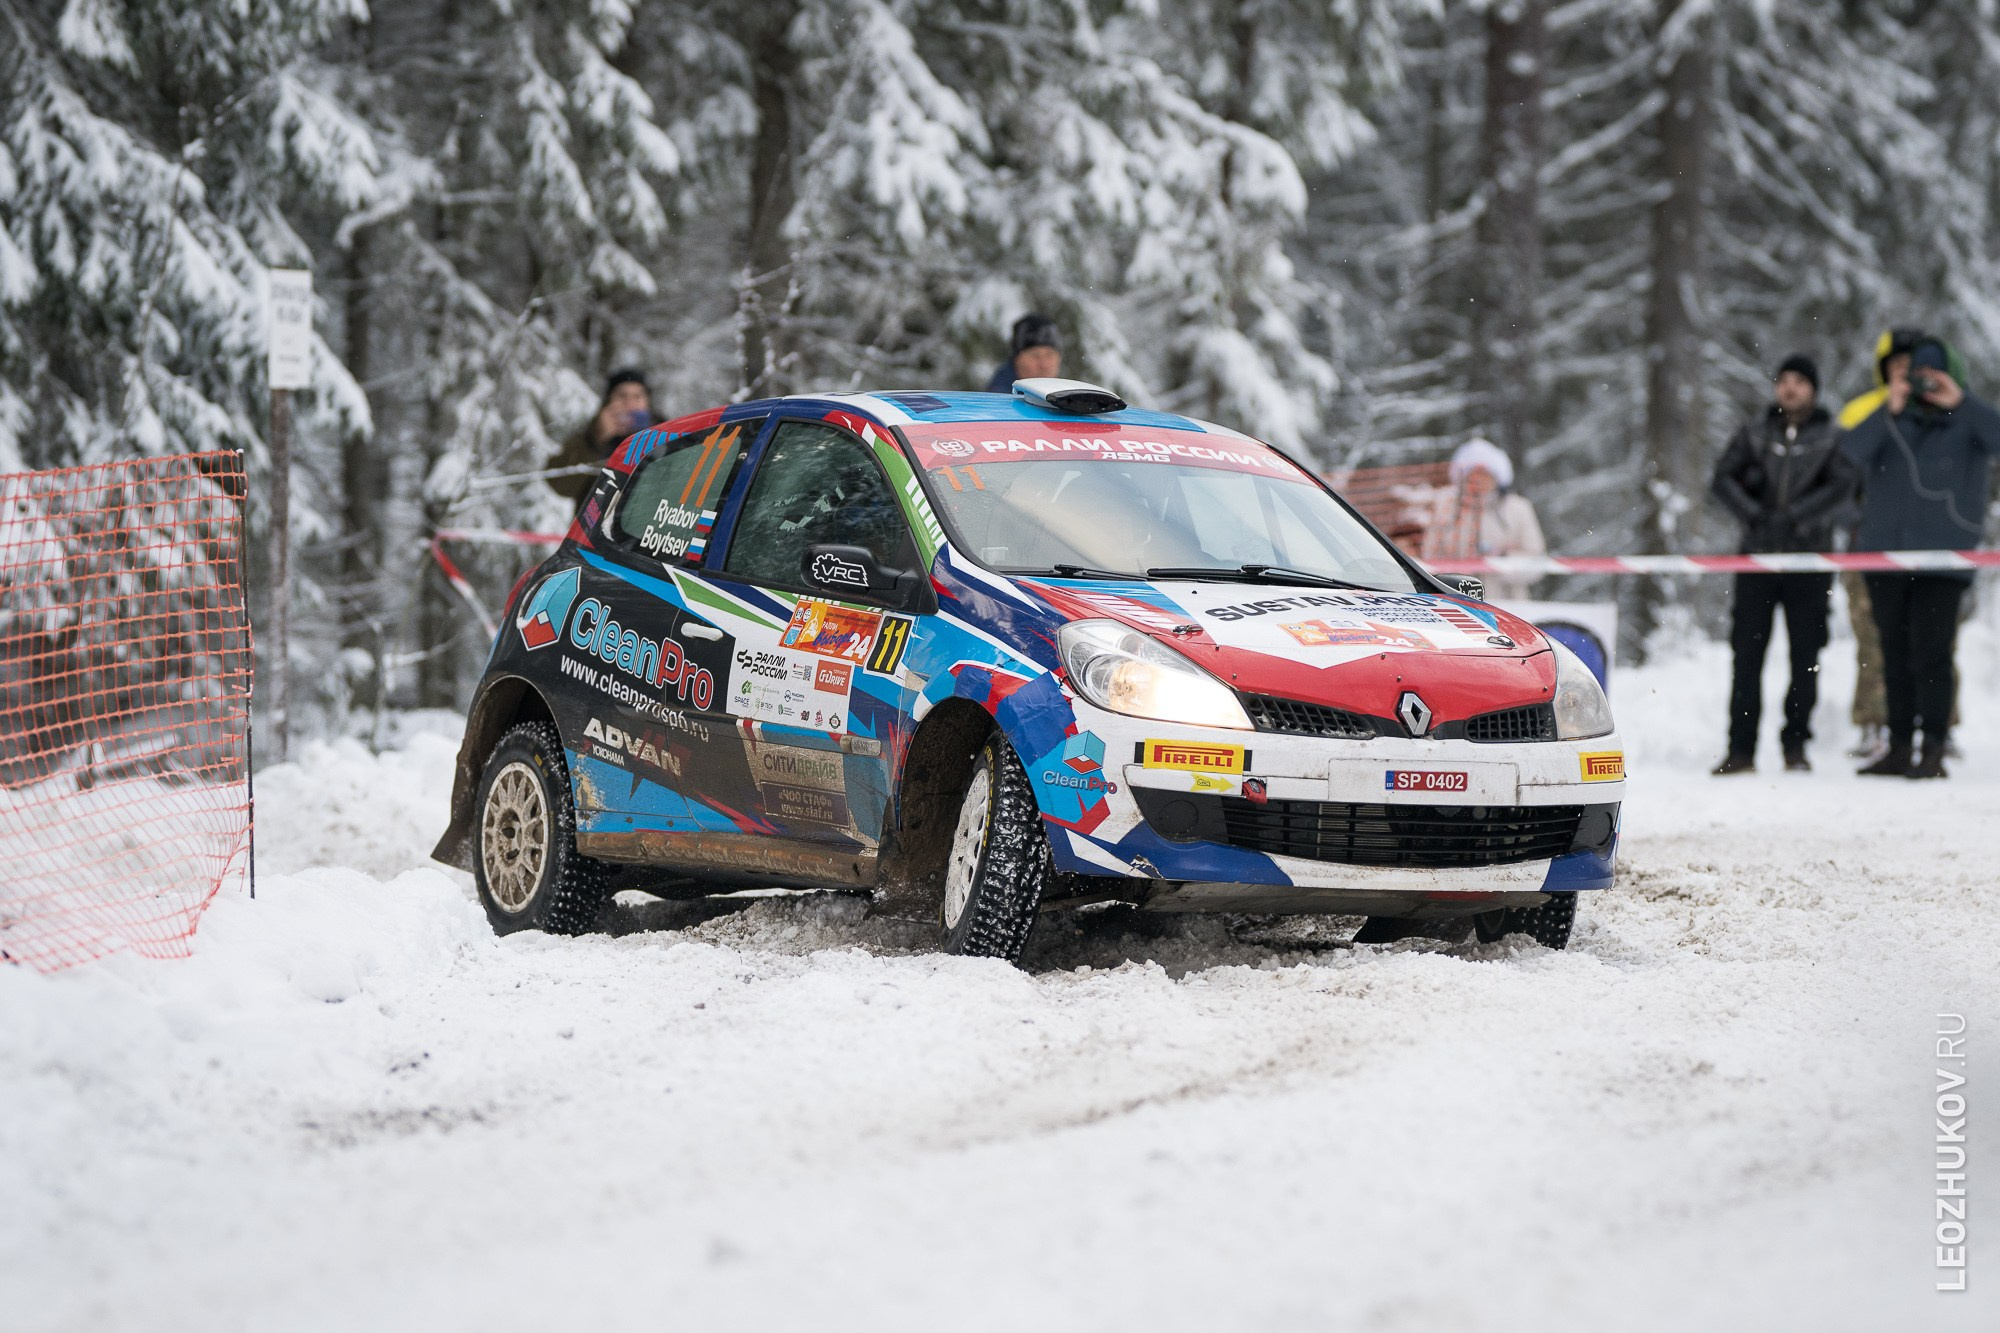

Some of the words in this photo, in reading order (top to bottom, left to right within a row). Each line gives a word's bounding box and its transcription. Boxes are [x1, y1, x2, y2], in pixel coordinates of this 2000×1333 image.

[679, 423, 742, 507] 11
[980, 438, 1114, 453] РАЛЛИ
[1119, 440, 1262, 468] РОССИИ
[936, 466, 985, 491] 11
[653, 499, 699, 529] Ryabov
[640, 525, 689, 557] Boytsev
[822, 564, 861, 580] VRC
[570, 597, 714, 711] CleanPro
[841, 633, 872, 659] 24
[874, 620, 908, 671] 11
[1378, 636, 1414, 647] 24
[751, 664, 788, 680] РОССИИ
[755, 652, 786, 667] РАЛЛИ
[583, 717, 681, 776] ADVAN
[592, 744, 625, 766] YOKOHAMA
[1153, 745, 1234, 767] PIRELLI
[1043, 770, 1117, 794] CleanPro
[1398, 772, 1421, 788] SP
[1426, 773, 1464, 789] 0402
